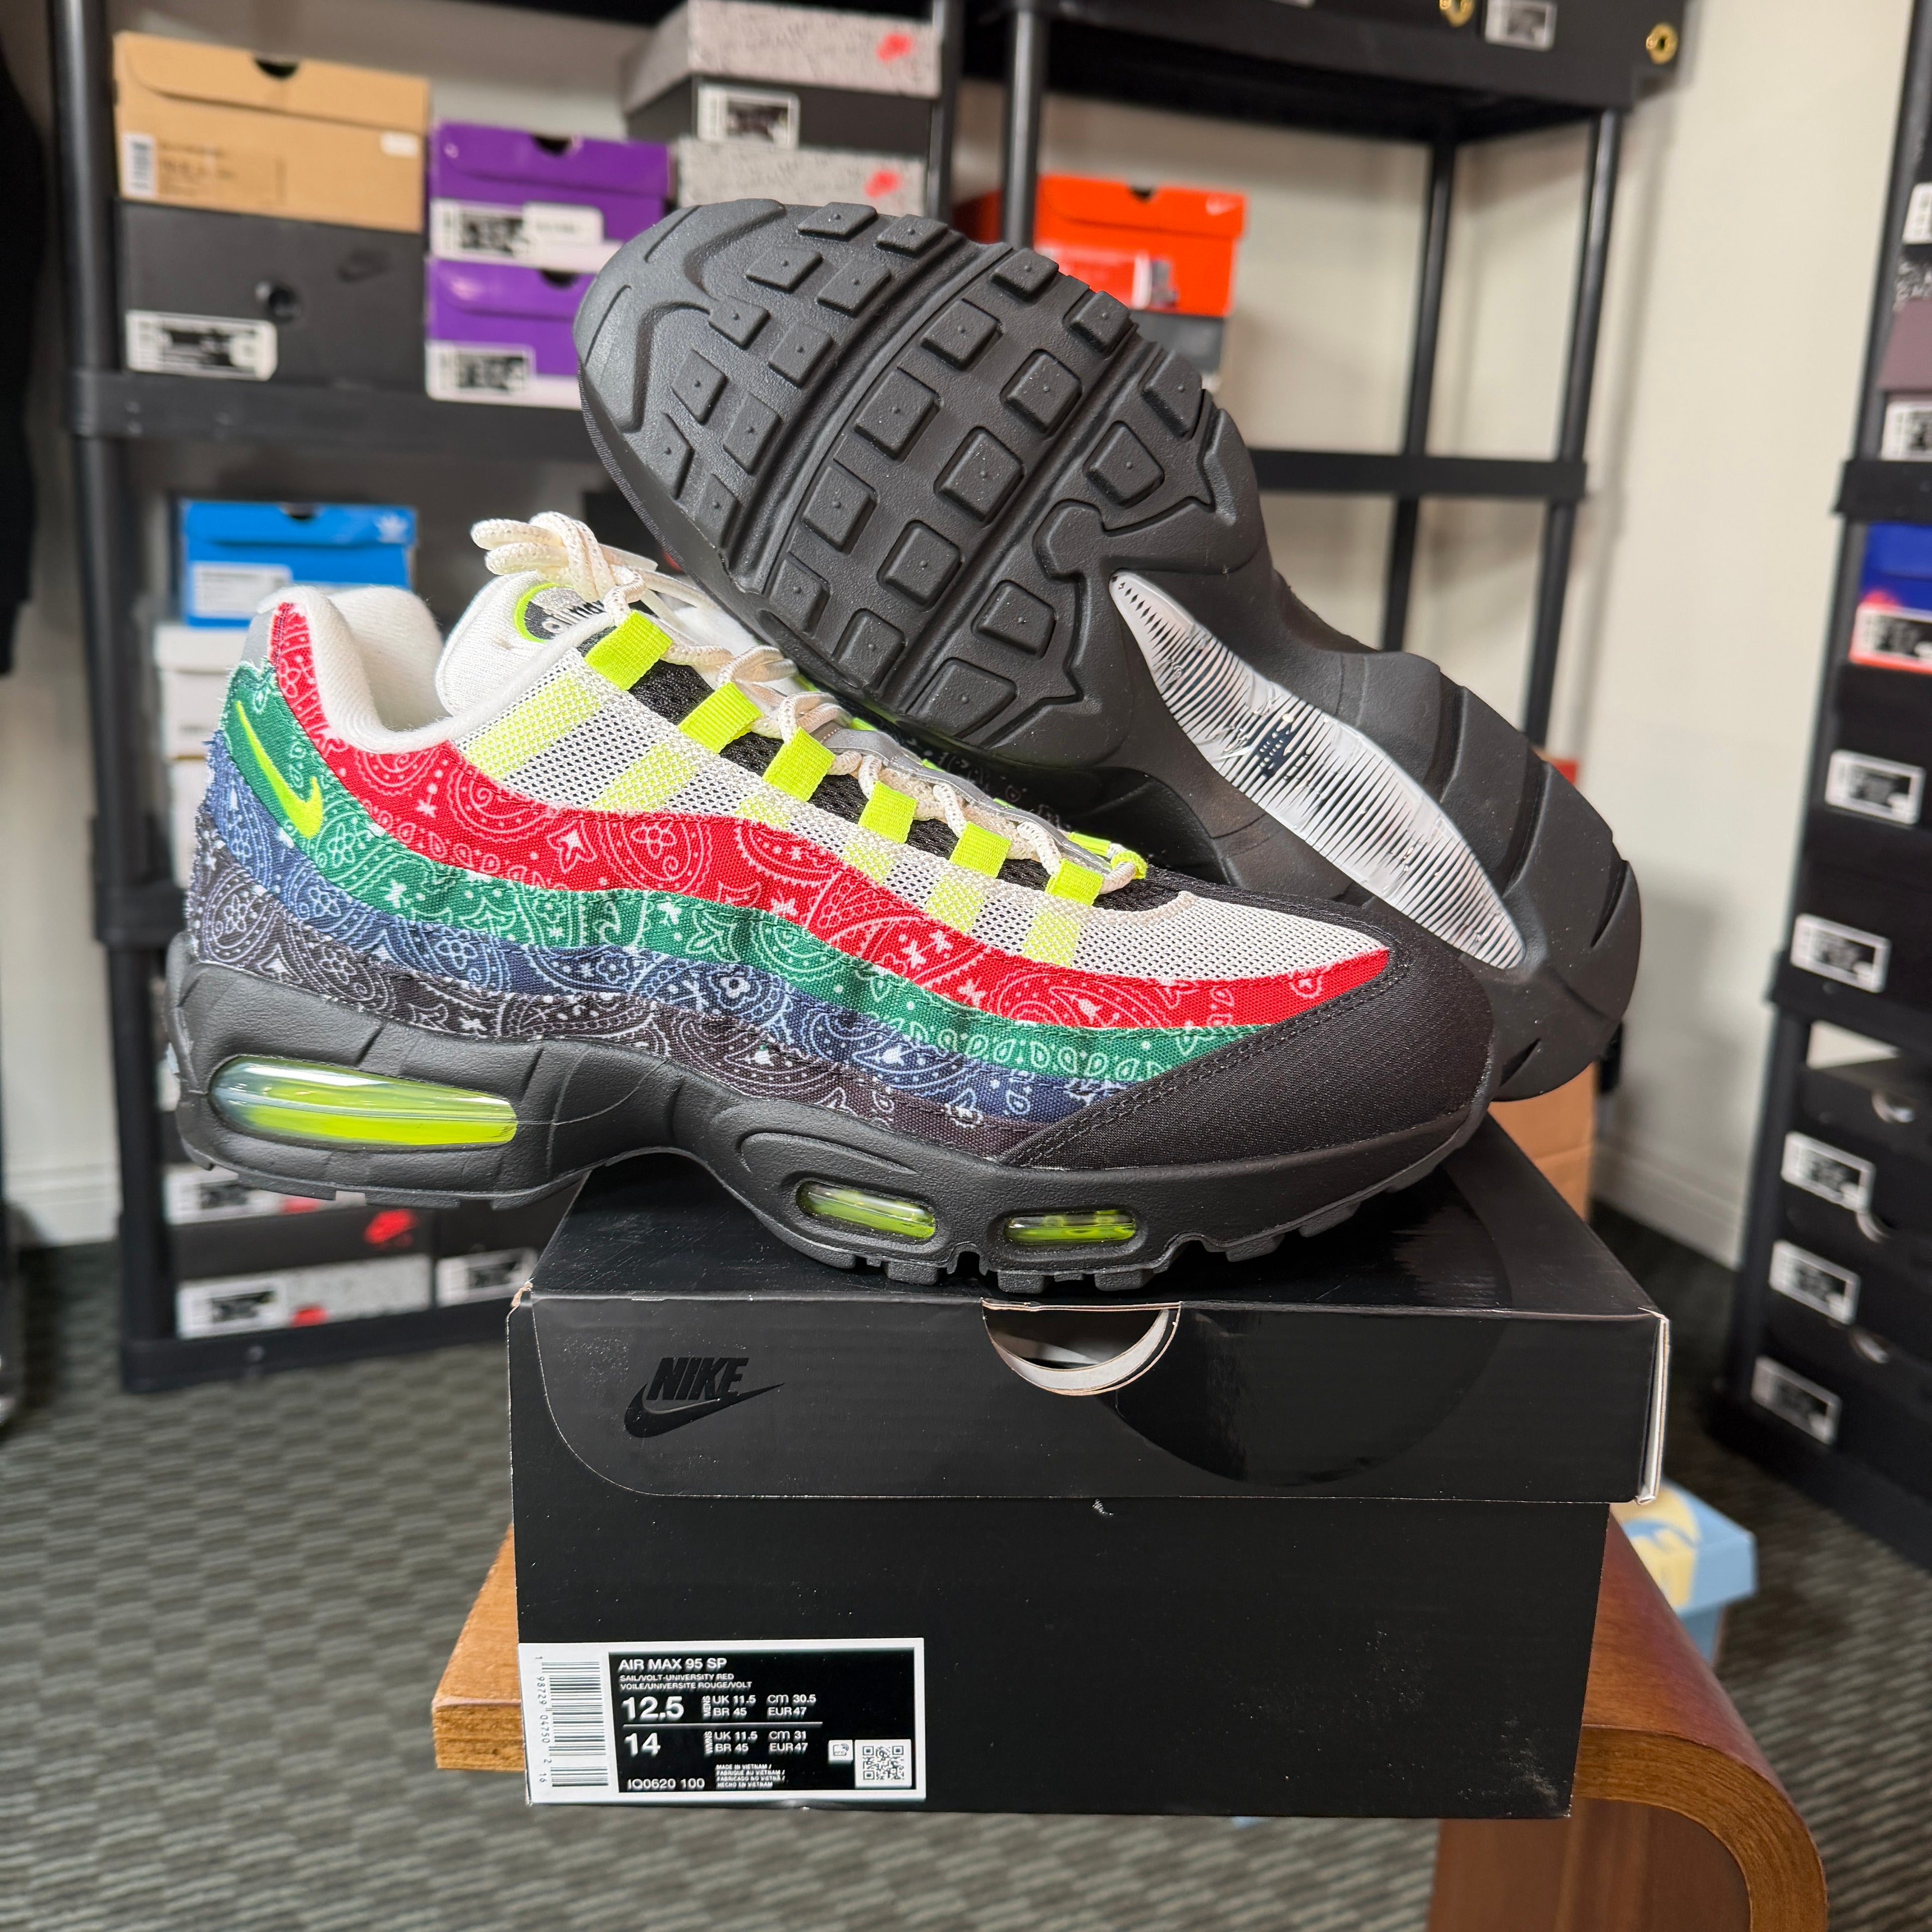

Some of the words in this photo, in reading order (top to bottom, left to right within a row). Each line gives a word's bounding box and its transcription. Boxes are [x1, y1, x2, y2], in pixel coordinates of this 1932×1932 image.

[647, 1357, 749, 1400] NIKE
[618, 1659, 645, 1670] AIR
[647, 1658, 682, 1670] MAX
[685, 1658, 703, 1670] 95
[706, 1657, 728, 1669] SP
[619, 1673, 714, 1682] SAIL/VOLT-UNIVERSITY
[715, 1673, 735, 1681] RED
[537, 1676, 547, 1705] 98729
[619, 1682, 696, 1691] VOILE/UNIVERSITE
[697, 1681, 753, 1689] ROUGE/VOLT
[702, 1695, 711, 1717] MENS
[712, 1695, 730, 1705] UK
[733, 1695, 756, 1706] 11.5
[792, 1694, 817, 1705] 30.5
[622, 1696, 684, 1721] 12.5
[712, 1707, 730, 1717] BR
[733, 1707, 748, 1717] 45
[767, 1707, 792, 1716] EUR
[792, 1707, 807, 1717] 47
[540, 1715, 550, 1744] 04750
[713, 1731, 731, 1741] UK
[734, 1731, 758, 1741] 11.5
[793, 1730, 807, 1741] 31
[625, 1732, 661, 1757] 14
[704, 1730, 713, 1754] WMNS
[714, 1743, 732, 1753] BR
[734, 1743, 749, 1753] 45
[769, 1742, 793, 1752] EUR
[793, 1742, 808, 1752] 47
[627, 1778, 676, 1789] IQ0620
[680, 1778, 705, 1789] 100
